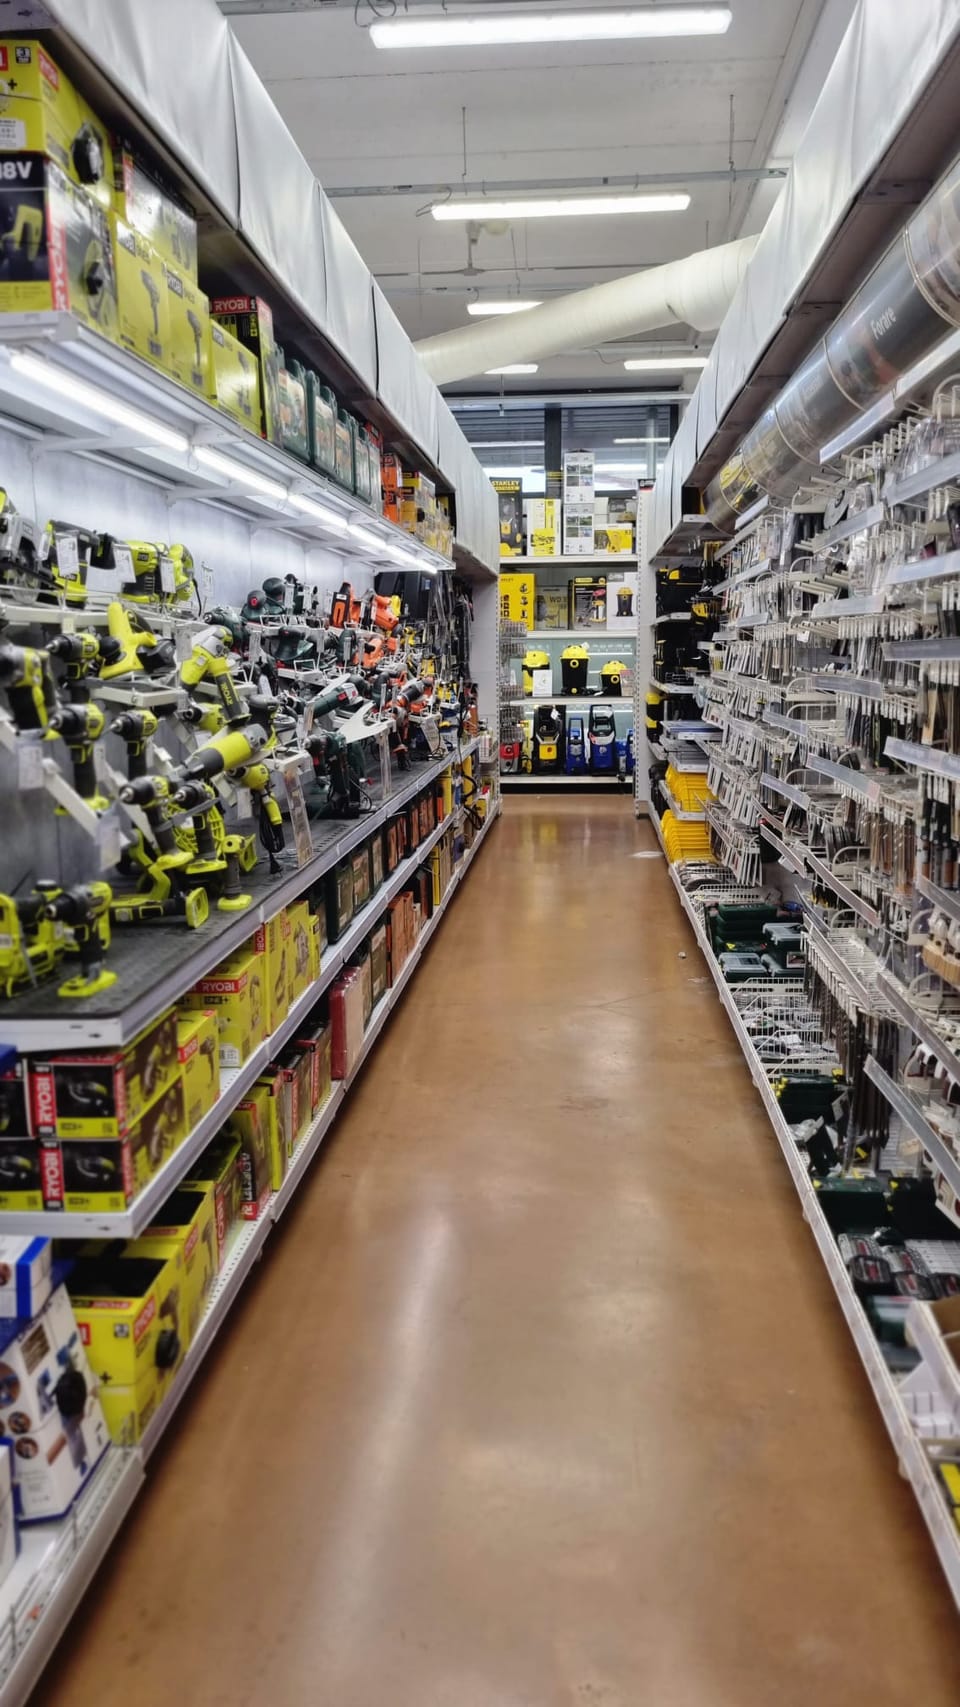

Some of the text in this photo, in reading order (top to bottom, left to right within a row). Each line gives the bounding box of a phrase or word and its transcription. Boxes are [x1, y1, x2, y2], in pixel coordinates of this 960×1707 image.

[214, 301, 247, 310] RYOBI
[871, 307, 896, 340] Forare
[203, 982, 234, 991] RYOBI
[38, 1077, 53, 1123] RYOBI
[45, 1152, 60, 1198] RYOBI
